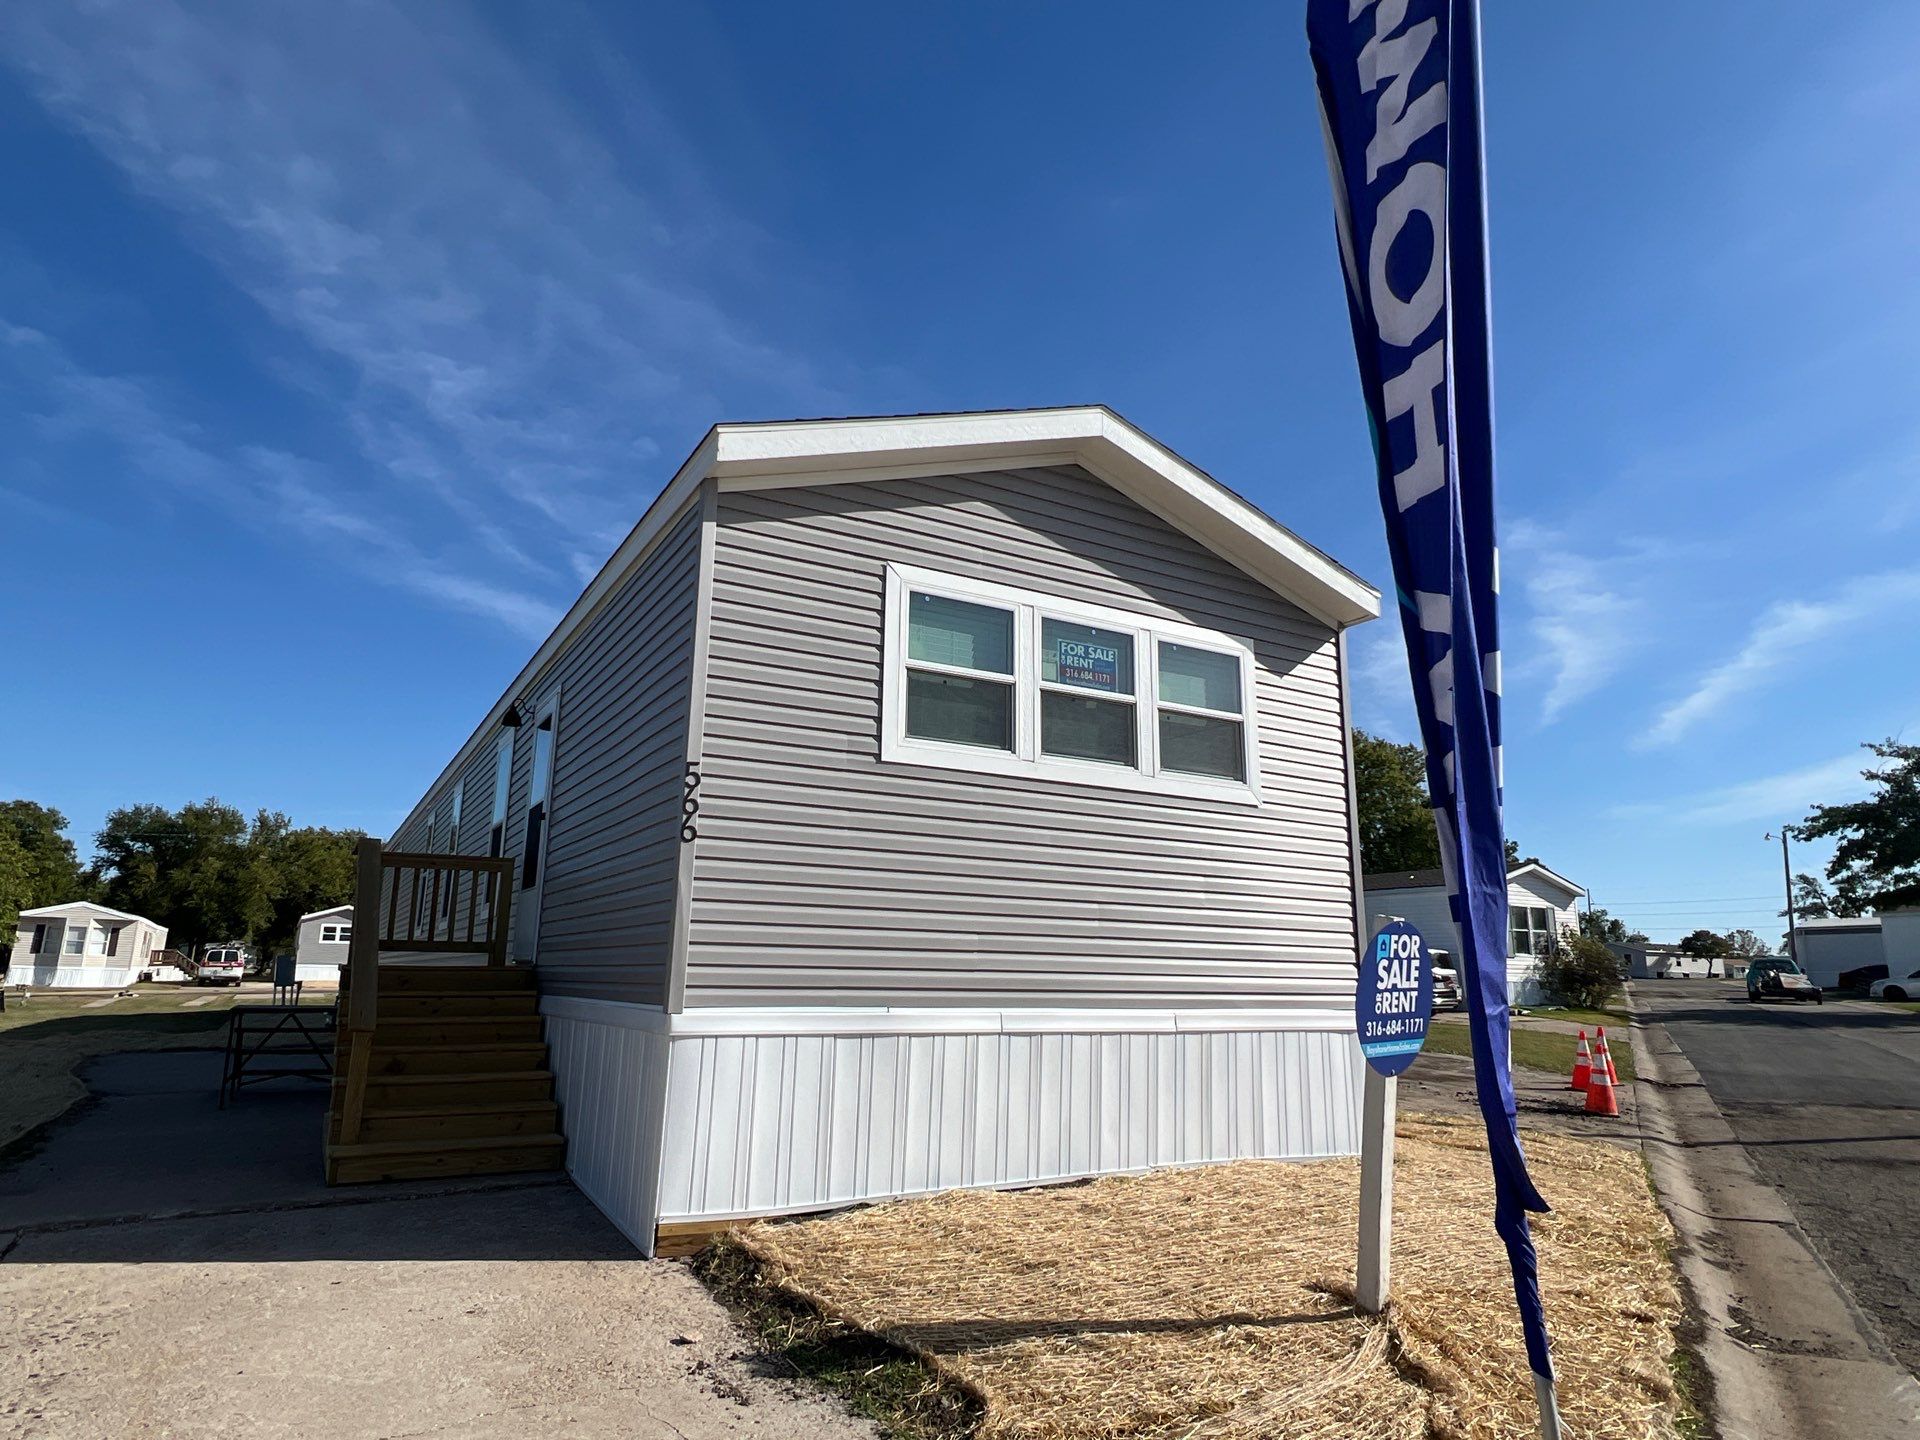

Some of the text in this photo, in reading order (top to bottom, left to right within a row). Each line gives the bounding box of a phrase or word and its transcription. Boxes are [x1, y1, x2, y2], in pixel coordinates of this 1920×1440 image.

[1348, 0, 1447, 513] HOM
[1061, 642, 1114, 662] FOR SALE
[1066, 655, 1094, 669] RENT
[1390, 934, 1421, 958] FOR
[1376, 959, 1420, 990] SALE
[1375, 990, 1418, 1014] OR RENT
[1366, 1018, 1423, 1037] 316-684-1171
